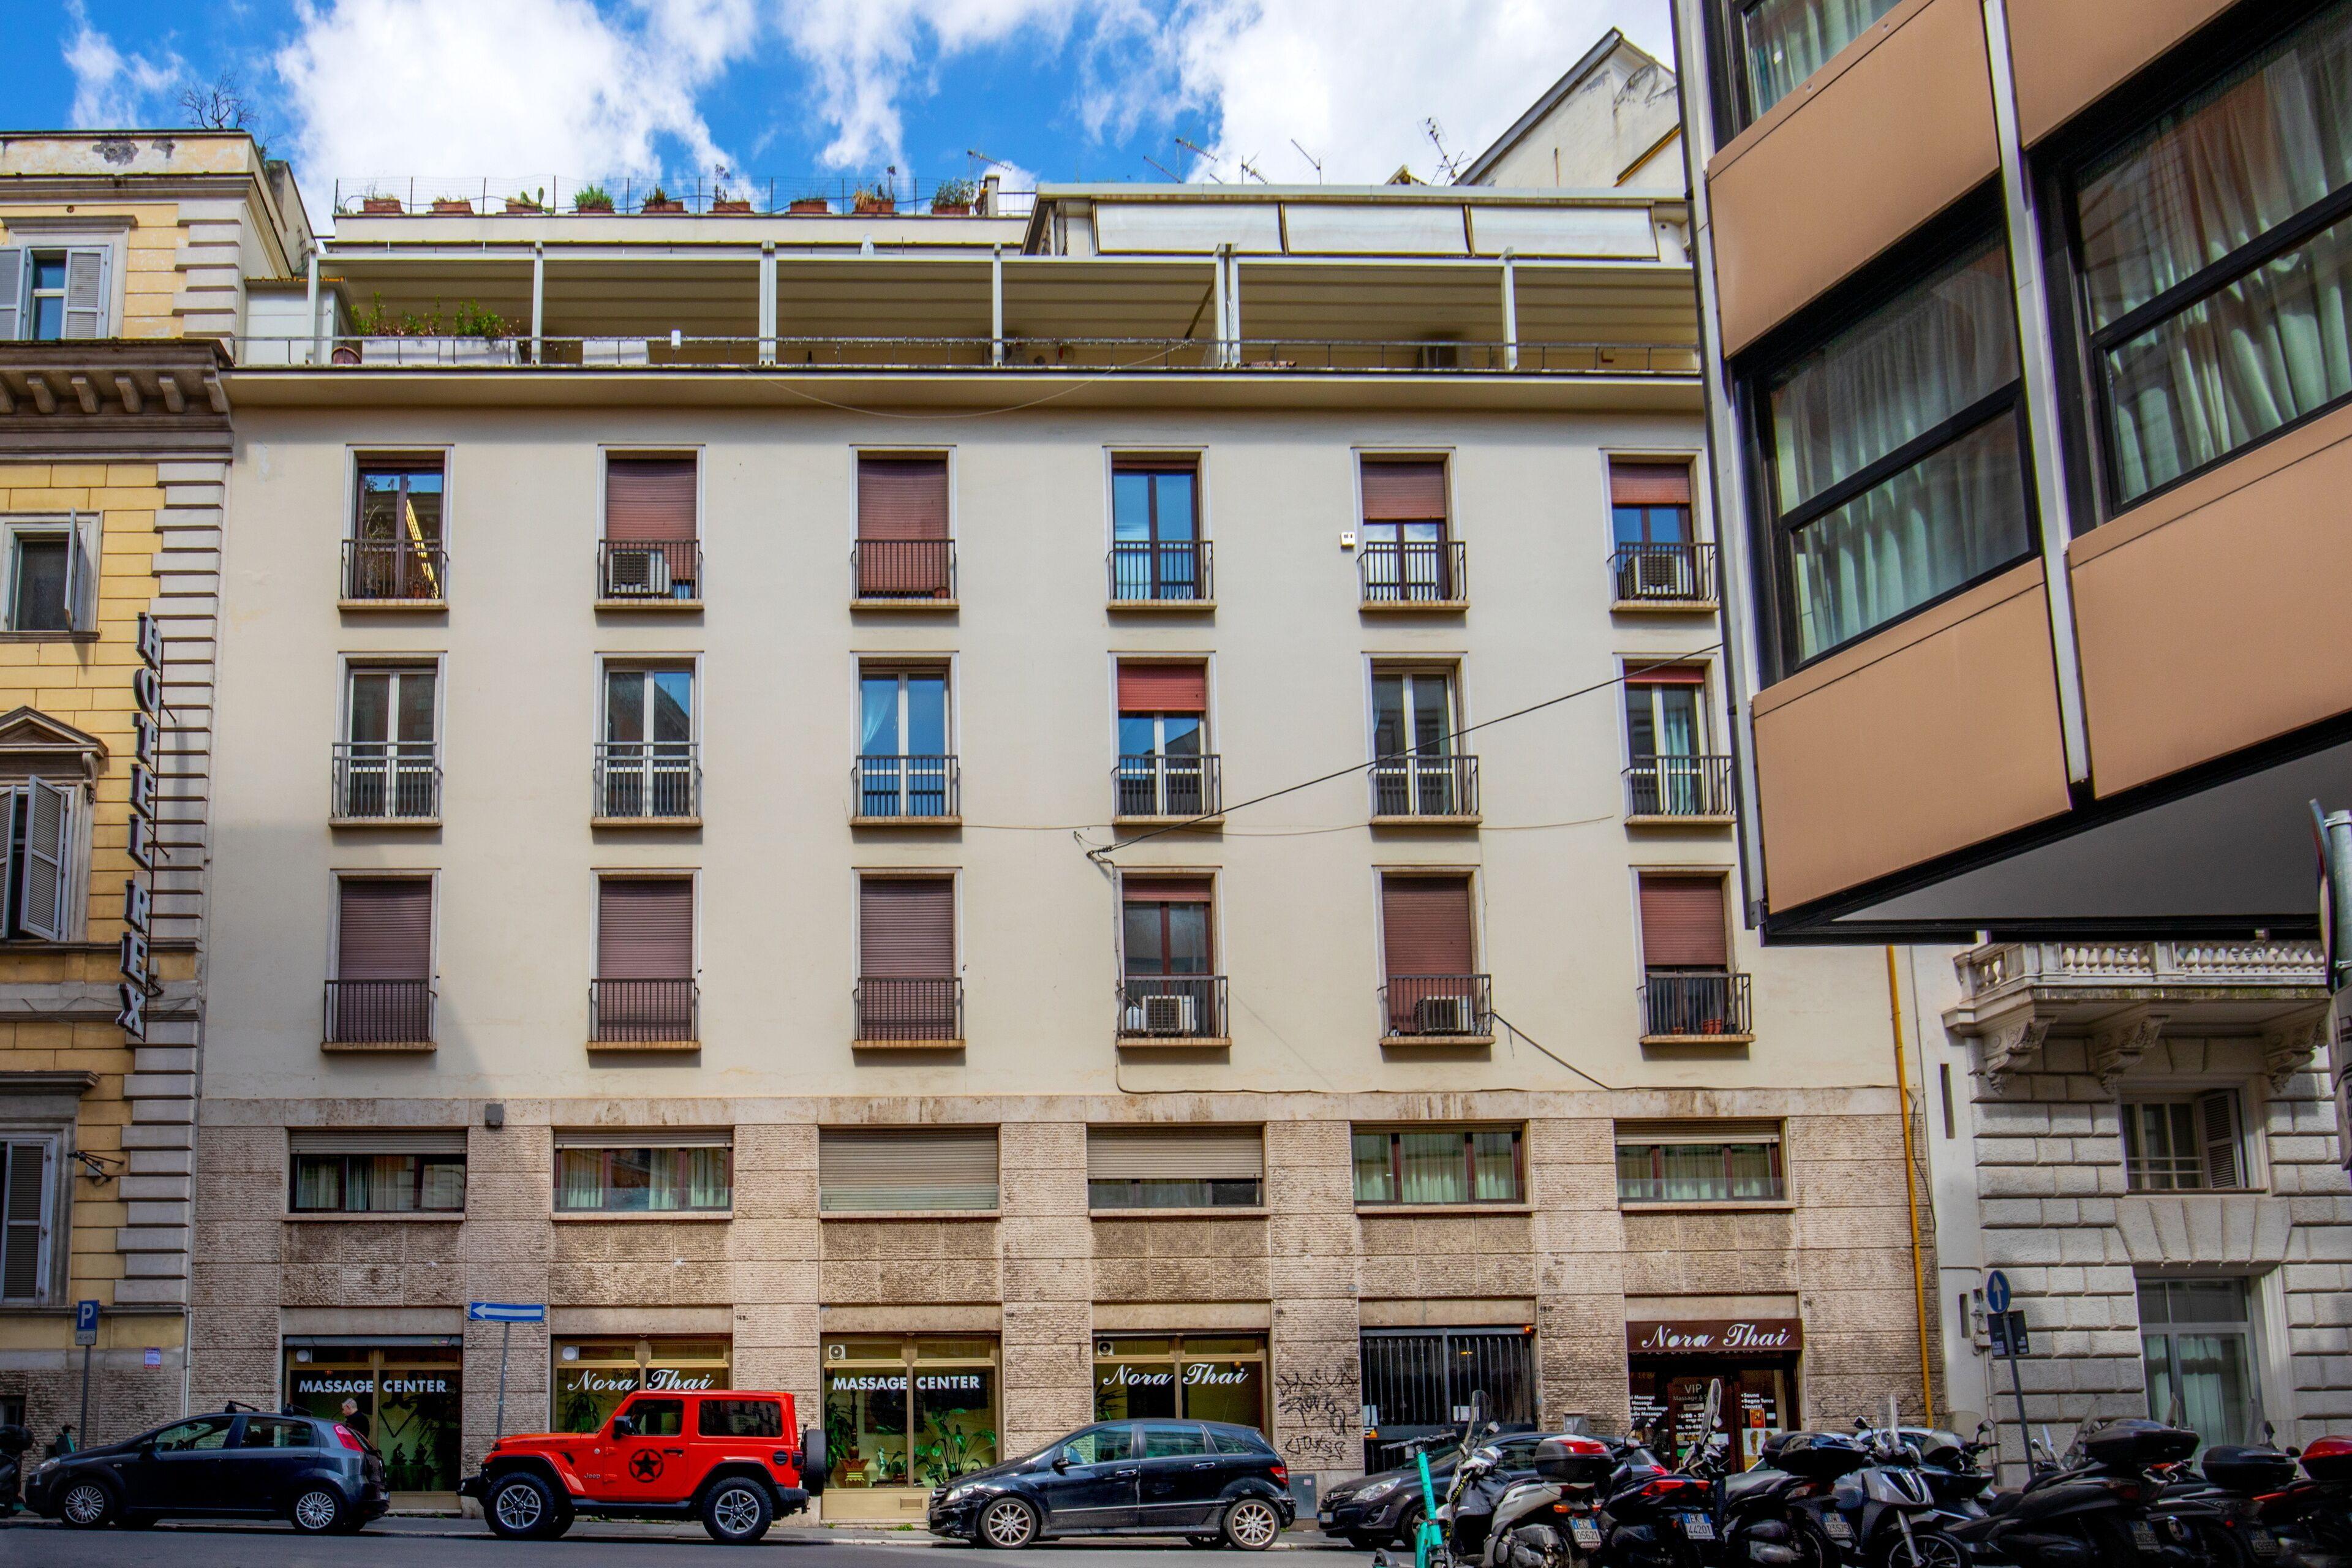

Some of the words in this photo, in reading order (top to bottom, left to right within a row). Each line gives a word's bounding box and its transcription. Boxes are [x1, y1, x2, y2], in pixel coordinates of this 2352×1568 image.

[126, 611, 162, 870] HOTEL
[115, 879, 151, 1041] REX
[80, 1303, 94, 1327] P
[1642, 1324, 1714, 1348] Nora
[1722, 1323, 1790, 1347] Thai
[567, 1369, 639, 1391] Nora
[646, 1369, 714, 1391] Thai
[832, 1377, 907, 1390] MASSAGE
[916, 1376, 980, 1390] CENTER
[1102, 1364, 1174, 1385] Nora
[1183, 1363, 1249, 1385] Thai
[298, 1380, 374, 1393] MASSAGE
[383, 1380, 447, 1393] CENTER
[1684, 1384, 1702, 1393] VIP
[1424, 1490, 1434, 1517] TIER
[1578, 1520, 1588, 1529] EC
[1690, 1514, 1700, 1523] EK
[1577, 1531, 1599, 1540] 05621
[1688, 1525, 1711, 1534] 44201
